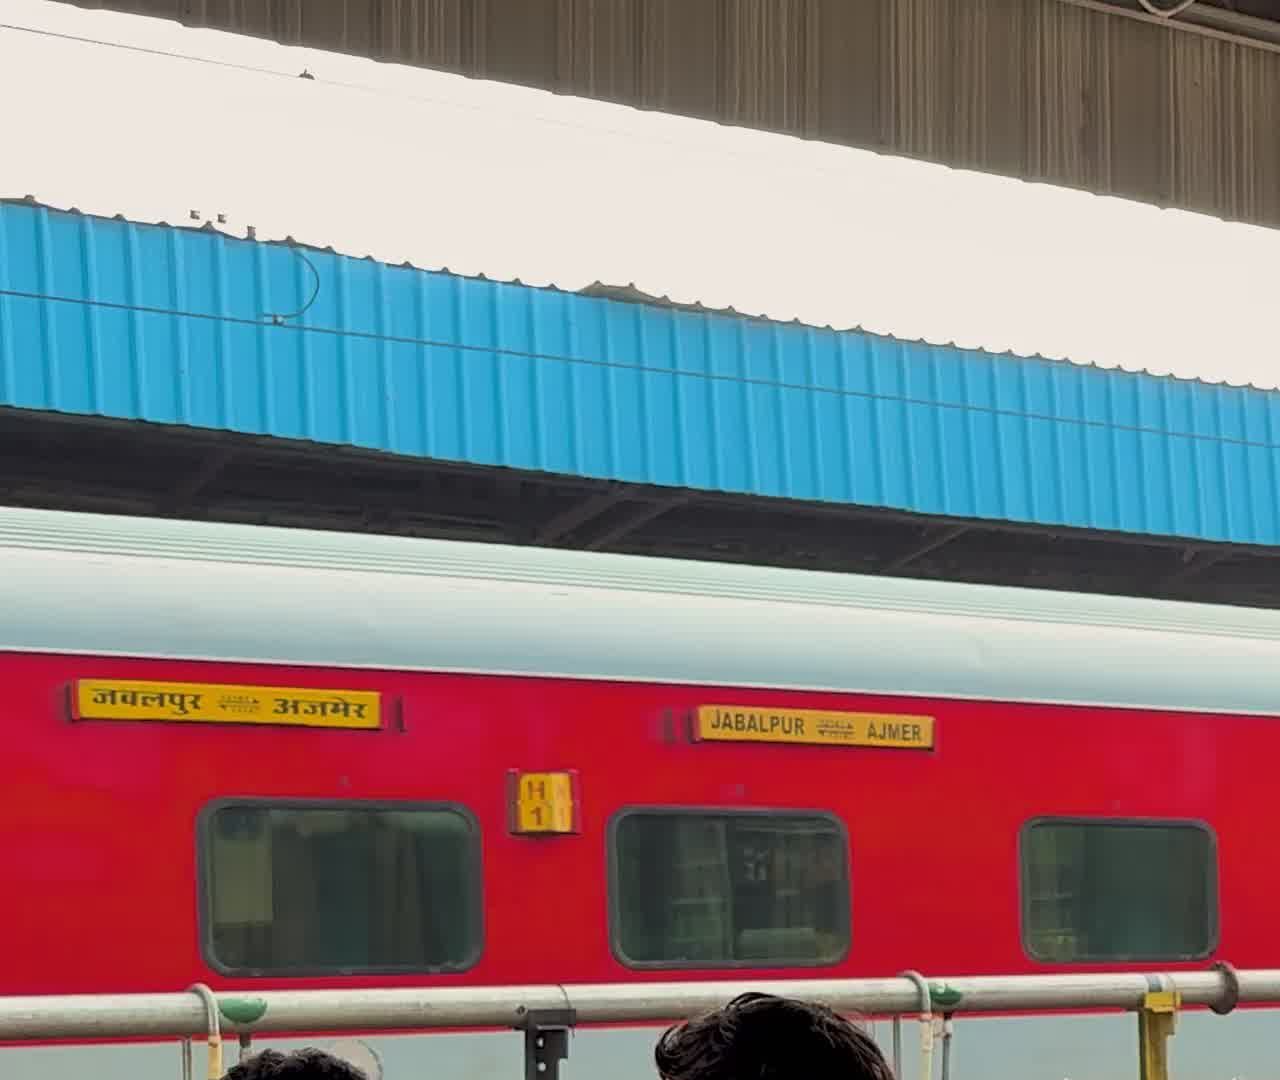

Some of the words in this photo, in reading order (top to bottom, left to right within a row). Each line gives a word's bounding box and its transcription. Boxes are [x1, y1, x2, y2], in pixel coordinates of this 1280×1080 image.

[710, 708, 805, 736] JABALPUR
[866, 722, 922, 742] AJMER
[527, 780, 545, 801] H
[530, 806, 543, 826] 1
